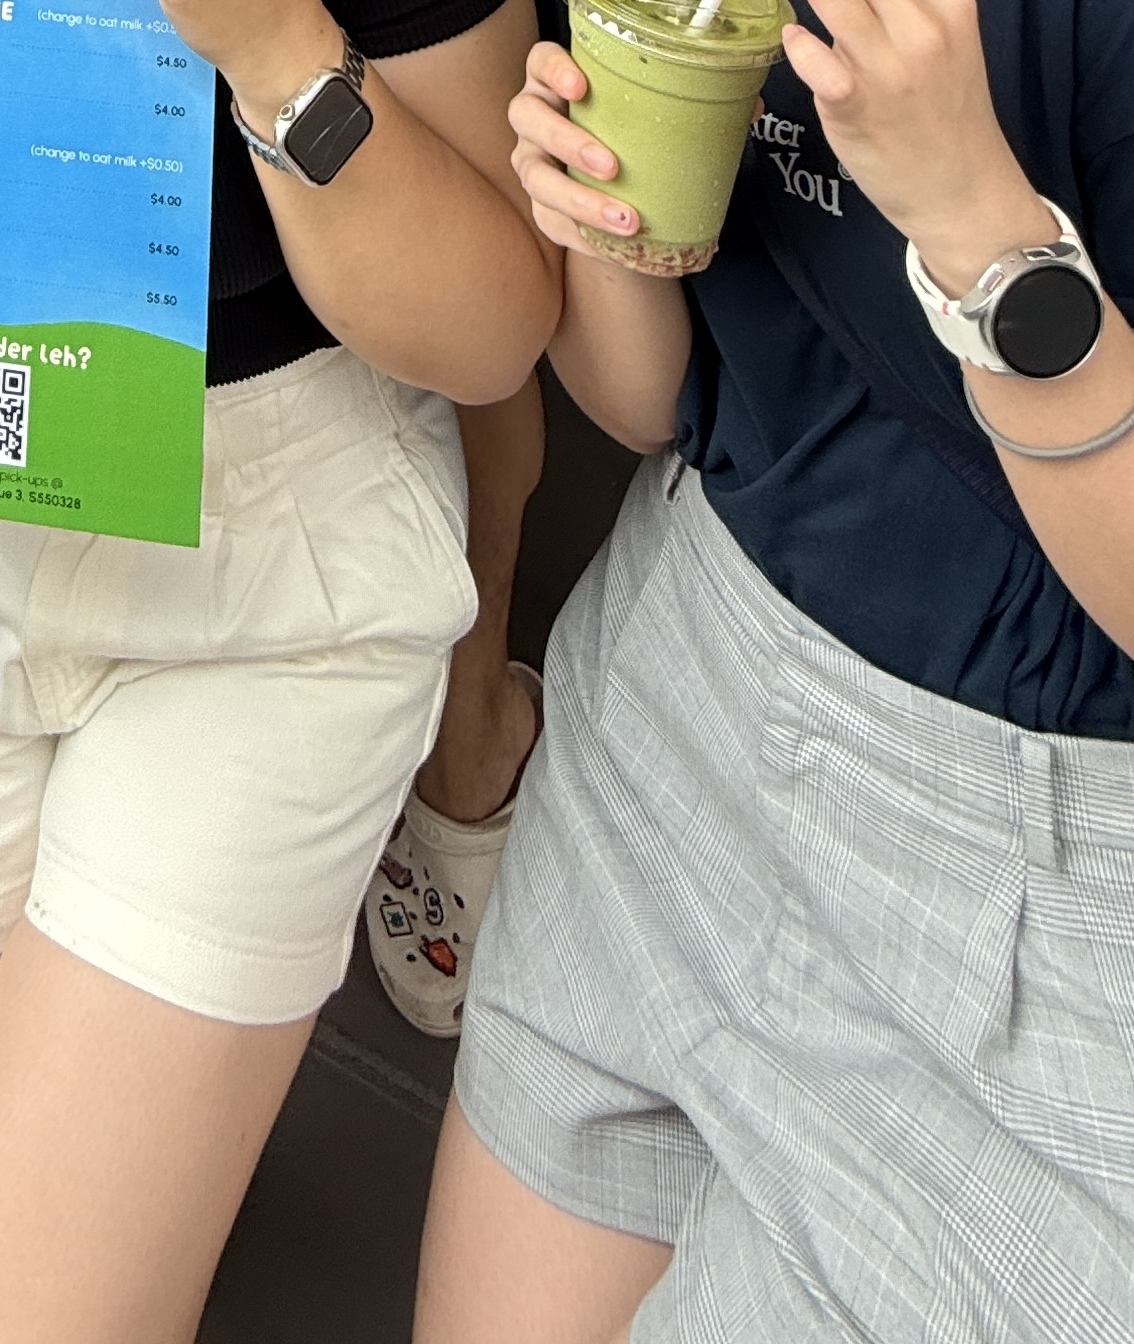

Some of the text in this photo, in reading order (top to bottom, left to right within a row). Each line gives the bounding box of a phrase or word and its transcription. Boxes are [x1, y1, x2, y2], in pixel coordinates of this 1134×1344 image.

[37, 9, 82, 27] (change
[85, 15, 97, 25] to
[98, 16, 117, 28] oat
[121, 19, 143, 31] milk
[157, 55, 187, 68] $4.50
[154, 103, 185, 117] $4.00
[750, 112, 805, 148] tter
[30, 144, 183, 173] (change to oat milk +$0.50)
[768, 152, 843, 217] You
[150, 193, 182, 207] $4.00
[148, 241, 180, 256] $4.50
[146, 291, 177, 306] $5.50
[40, 343, 92, 370] leh?
[0, 471, 48, 488] pick-ups
[50, 477, 63, 490] @
[28, 491, 81, 510] S550328
